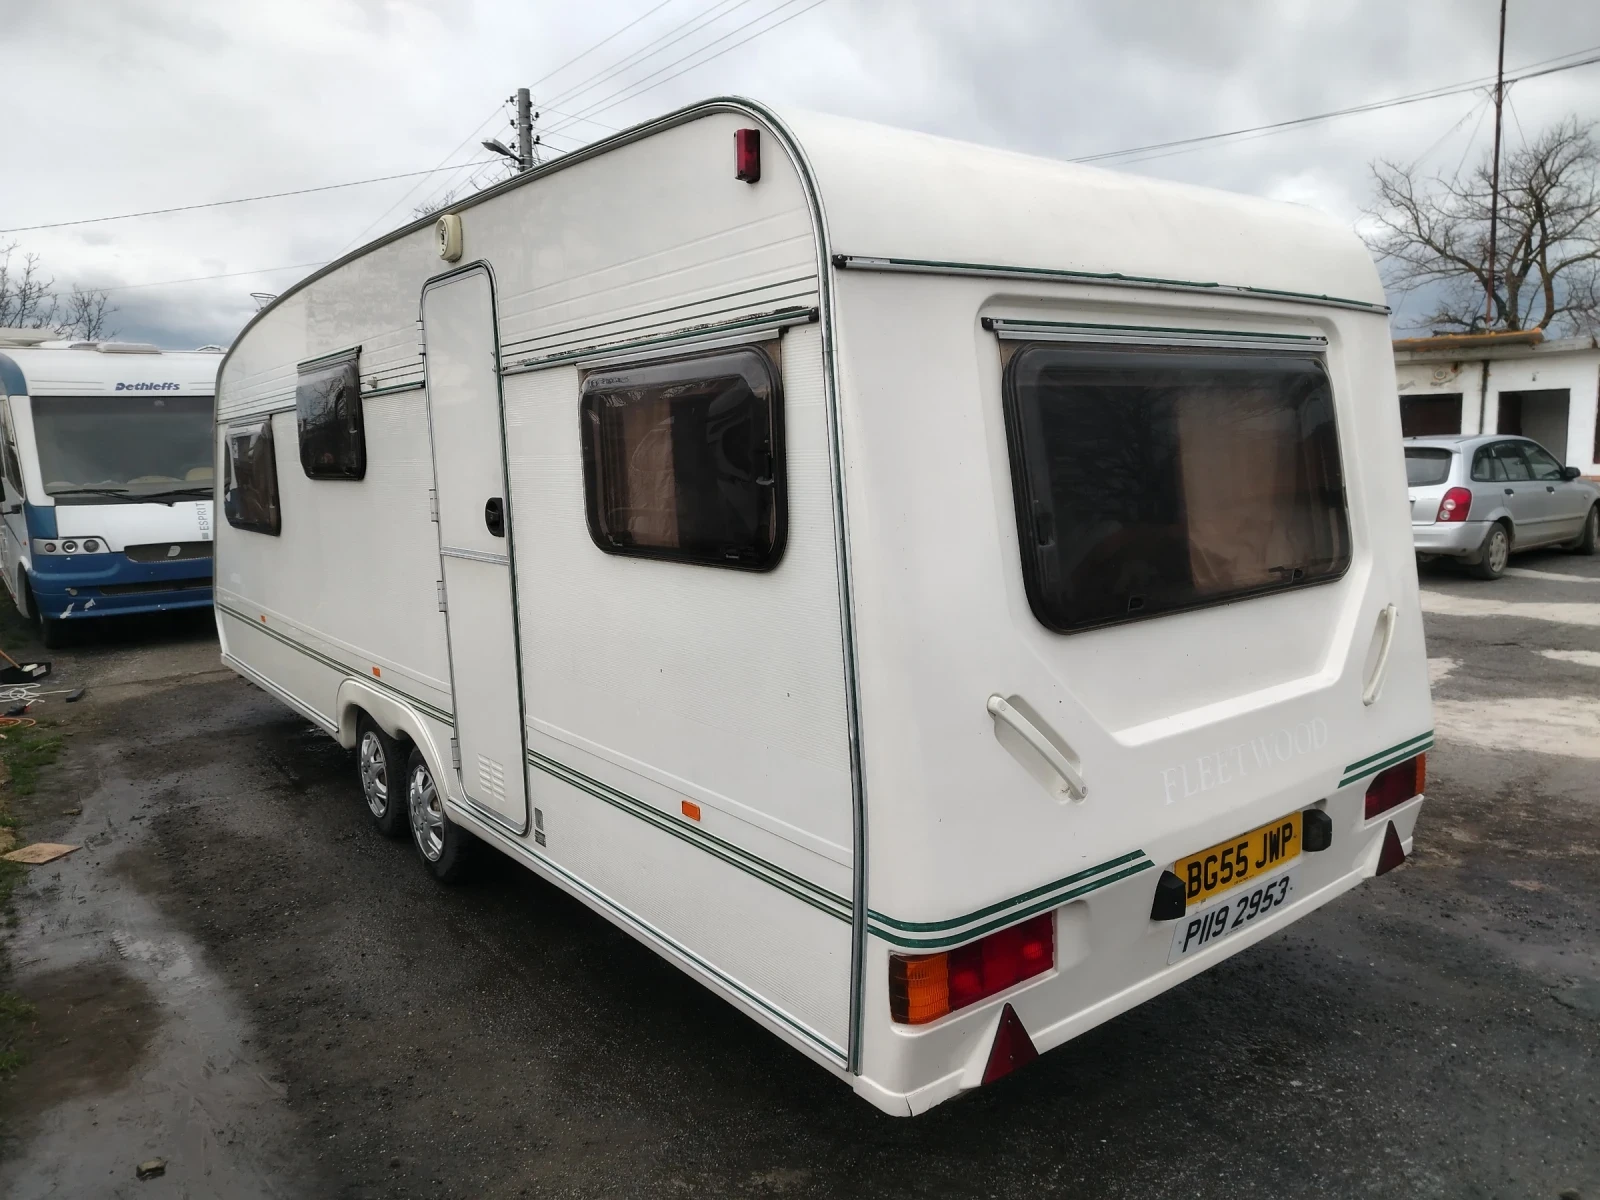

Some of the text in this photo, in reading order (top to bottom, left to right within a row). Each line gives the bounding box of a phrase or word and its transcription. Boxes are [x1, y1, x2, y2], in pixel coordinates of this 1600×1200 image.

[115, 382, 180, 391] Dethleffs
[195, 502, 209, 531] ESPRIT
[1160, 716, 1328, 806] FLEETWOOD
[1187, 822, 1293, 899] BG55 JWP
[1231, 876, 1290, 929] 2953
